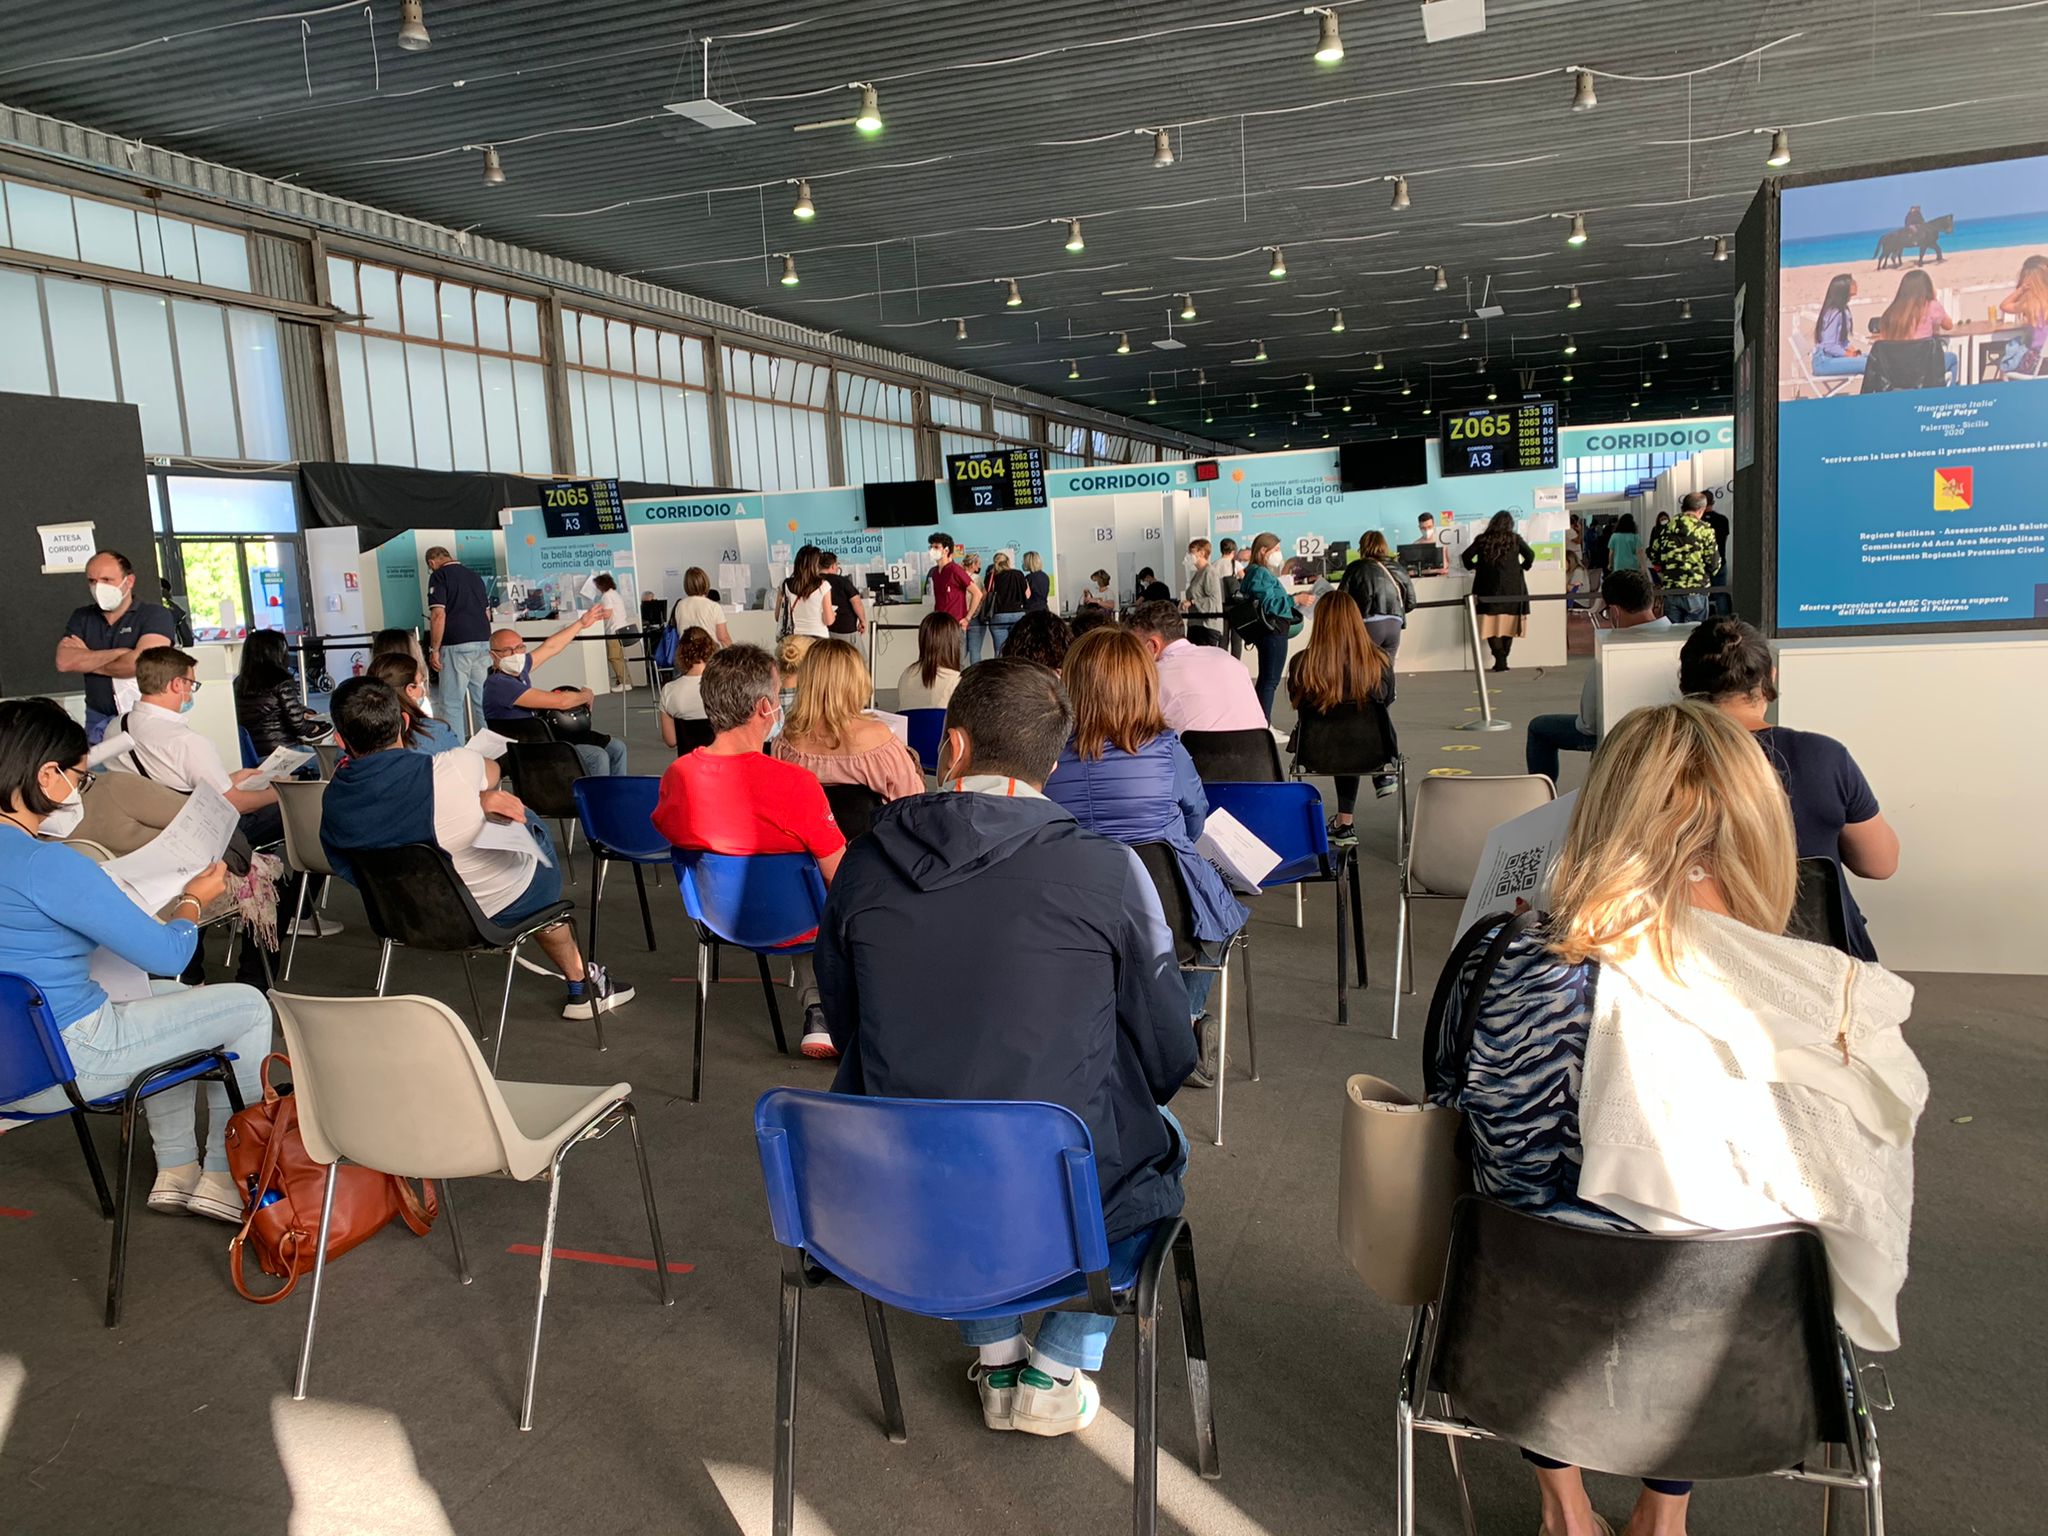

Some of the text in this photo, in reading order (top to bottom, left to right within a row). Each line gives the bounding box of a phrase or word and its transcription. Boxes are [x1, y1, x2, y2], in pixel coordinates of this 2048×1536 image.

[1914, 399, 1998, 413] "Risorgiamo Italia"
[1519, 408, 1540, 417] L333
[1932, 410, 1952, 419] Igor
[1450, 414, 1511, 440] Z065
[1519, 418, 1540, 427] Z063
[1920, 424, 1956, 432] Palermo
[1962, 420, 1989, 428] Sicilia
[1519, 427, 1553, 436] Z061 B4
[1944, 428, 1965, 437] 2020
[1519, 437, 1554, 446] Z058 B2
[1586, 427, 1732, 451] CORRIDOIO C
[1030, 451, 1038, 460] E4
[1520, 447, 1554, 456] V293 A4
[1908, 450, 1936, 458] blocca
[1946, 446, 1986, 456] presente
[1988, 442, 2035, 451] attraverso
[1470, 452, 1491, 468] A3
[1520, 456, 1554, 466] V292 A4
[955, 458, 1005, 480] Z064
[1012, 471, 1029, 479] Z059
[1013, 480, 1030, 488] Z057
[1069, 470, 1187, 491] CORRIDOIO B
[1251, 483, 1342, 498] la bella stagion
[545, 488, 589, 507] Z065
[974, 492, 992, 506] D2
[1251, 493, 1344, 509] comincia da qui
[646, 502, 746, 520] CORRIDOIO A
[566, 518, 580, 530] A3
[1096, 528, 1113, 541] B3
[1146, 528, 1160, 540] B5
[1438, 528, 1460, 545] C1
[1860, 532, 1894, 540] Regione
[1896, 530, 1935, 538] Siciliana
[1944, 526, 1997, 535] Assessorato
[1999, 524, 2017, 532] Alla
[2019, 522, 2048, 530] Salute
[54, 534, 81, 542] ATTESA
[804, 534, 883, 545] la bella stagione
[1862, 541, 1920, 551] Commissario
[1922, 540, 1933, 548] Ad
[1979, 535, 2045, 544] Metropolitana
[48, 544, 90, 553] CORRIDOIO
[851, 544, 863, 553] da
[866, 543, 880, 554] qui
[1299, 539, 1320, 555] B2
[541, 549, 612, 560] la bella stagione
[722, 550, 738, 562] A3
[1862, 546, 2045, 563] Dipartimento Regionale Protezione Civile
[542, 558, 611, 569] comincia da qui
[891, 566, 907, 579] B1
[510, 584, 526, 598] A1
[1832, 602, 1883, 611] patrocinata
[1885, 600, 1897, 608] da
[1899, 599, 1920, 607] MSC
[1921, 598, 1960, 606] Crociere
[1969, 596, 2008, 605] supporto
[1877, 606, 1918, 614] vaccinale
